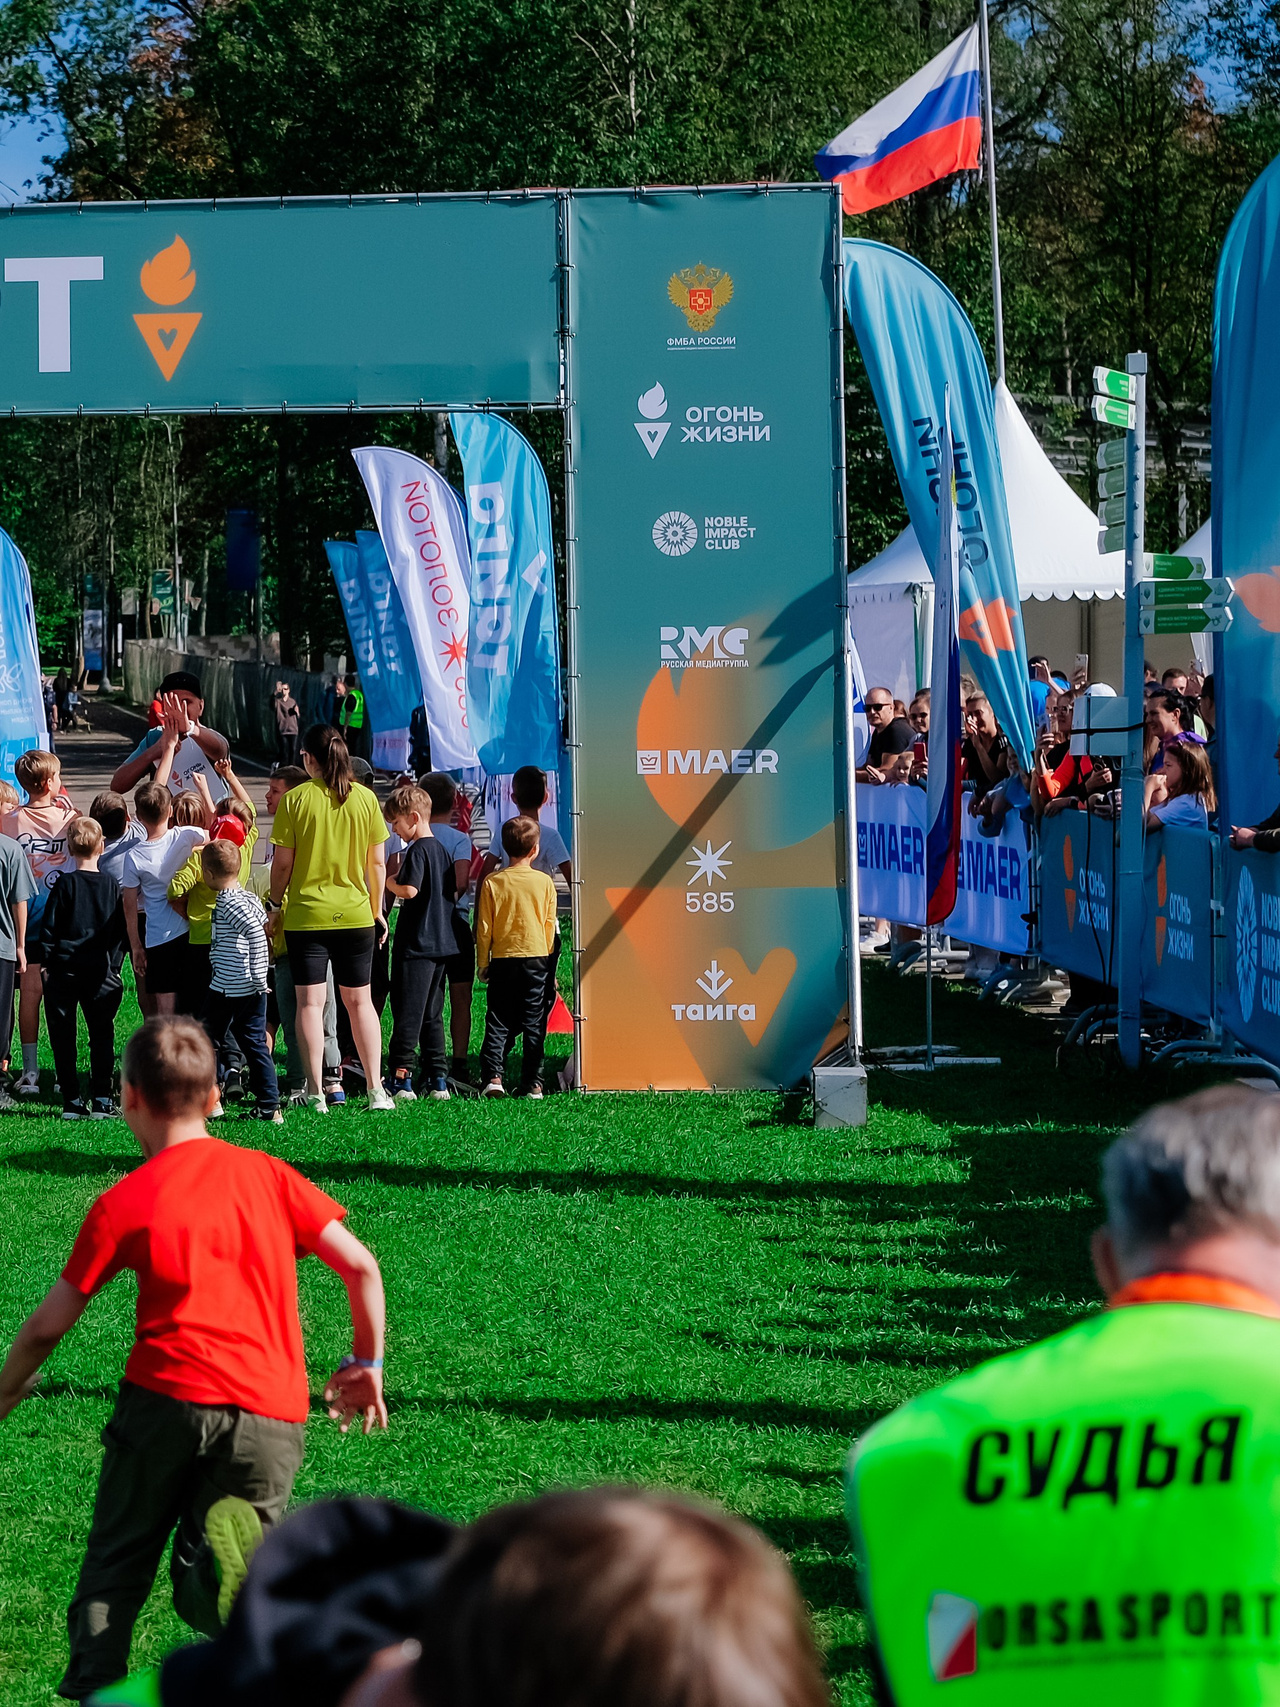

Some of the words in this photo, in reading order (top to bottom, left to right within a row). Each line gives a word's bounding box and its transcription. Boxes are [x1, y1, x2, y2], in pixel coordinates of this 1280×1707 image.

[667, 337, 695, 346] ФМБА
[698, 336, 736, 345] РОССИИ
[685, 406, 764, 423] ОГОНЬ
[680, 425, 771, 443] ЖИЗНИ
[704, 516, 748, 527] NOBLE
[704, 528, 756, 539] IMPACT
[704, 539, 741, 550] CLUB
[660, 660, 694, 668] РУССКАЯ
[695, 660, 749, 669] МЕДИАГРУППА
[668, 750, 779, 774] MAER
[870, 823, 925, 876] MAER
[966, 840, 1021, 902] MAER
[685, 892, 735, 913] 585
[1170, 892, 1192, 925] ОГОНЬ
[1168, 927, 1194, 962] ЖИЗНИ
[963, 1415, 1241, 1512] СУДЬЯ
